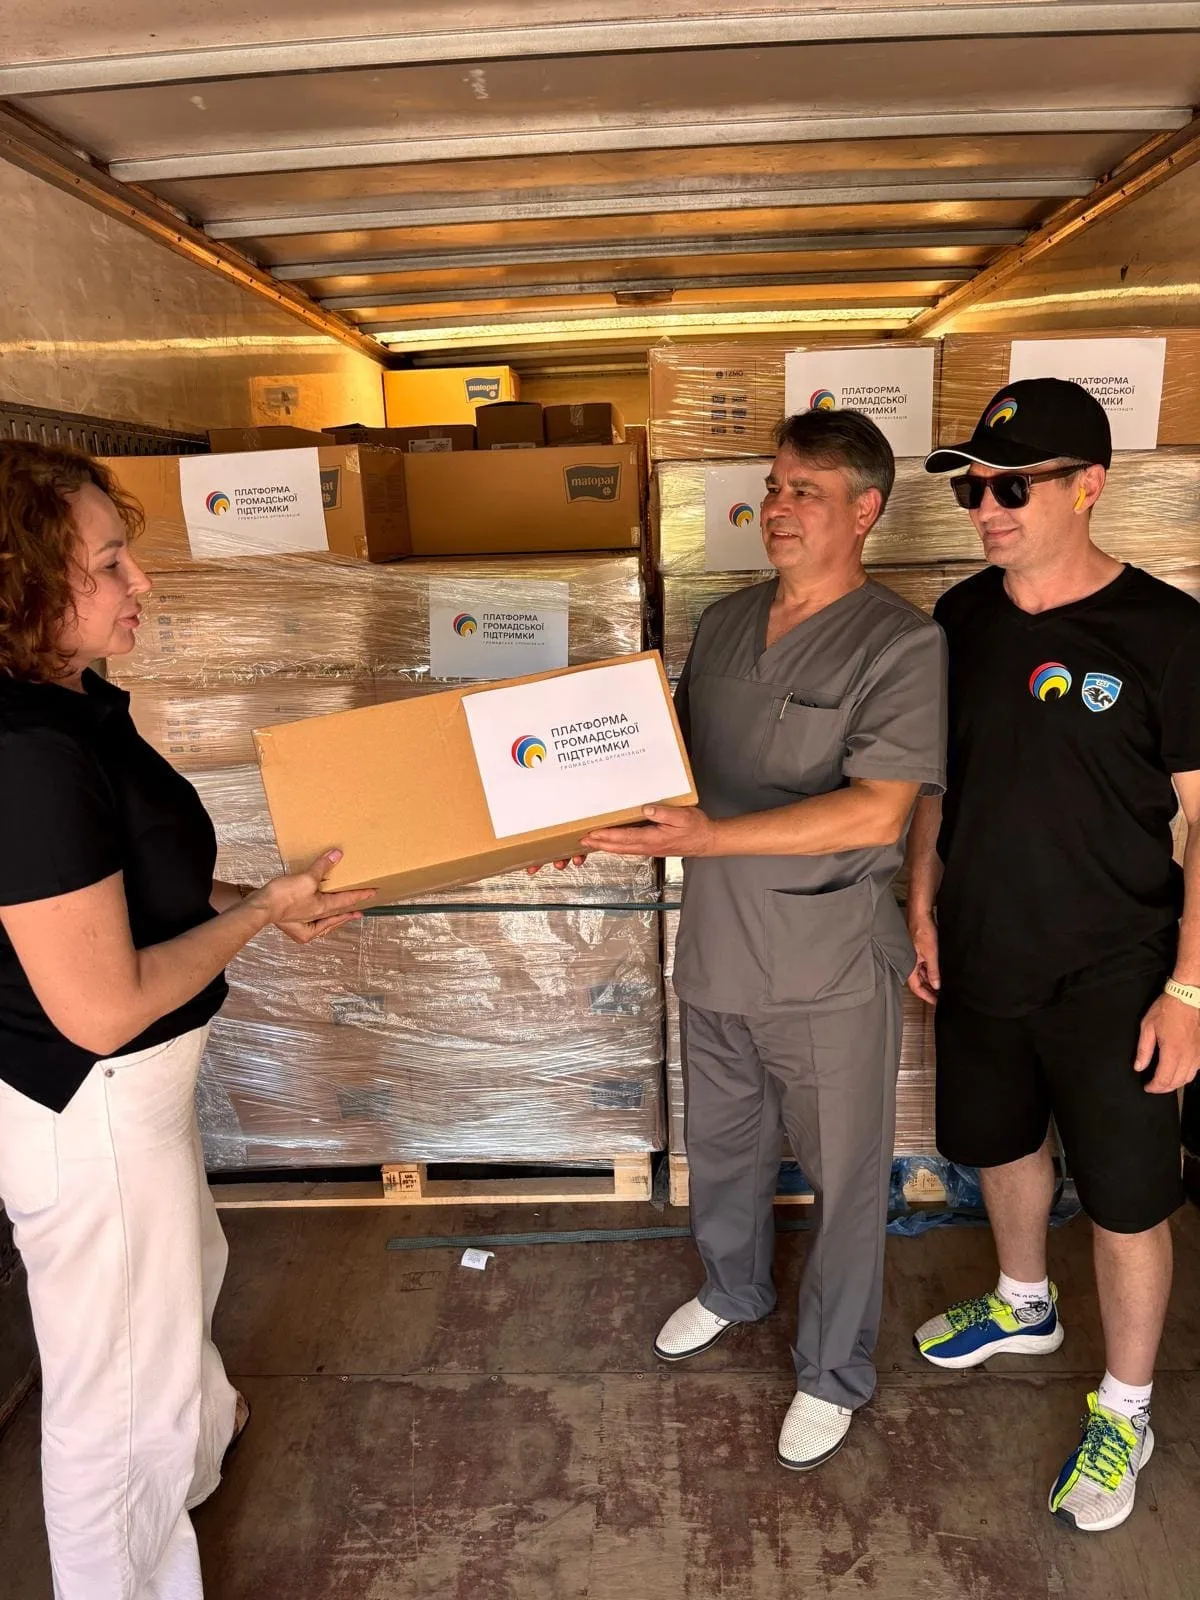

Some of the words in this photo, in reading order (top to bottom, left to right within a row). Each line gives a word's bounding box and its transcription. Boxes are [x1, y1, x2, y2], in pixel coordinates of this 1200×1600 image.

[842, 386, 901, 395] ПЛАТФОРМА
[1086, 385, 1136, 396] МАДСЬКОЇ
[841, 394, 908, 405] ГРОМАДСЬКОЇ
[234, 486, 291, 496] ПЛАТФОРМА
[235, 493, 298, 506] ГРОМАДСЬКОЇ
[236, 505, 290, 515] ПІДТРИМКИ
[483, 613, 538, 621] ПЛАТФОРМА
[483, 622, 545, 631] ГРОМАДСЬКОЇ
[551, 713, 628, 738] ПЛАТФОРМА
[554, 722, 640, 750] ГРОМАДСЬКОЇ
[557, 739, 630, 763] ПІДТРИМКИ
